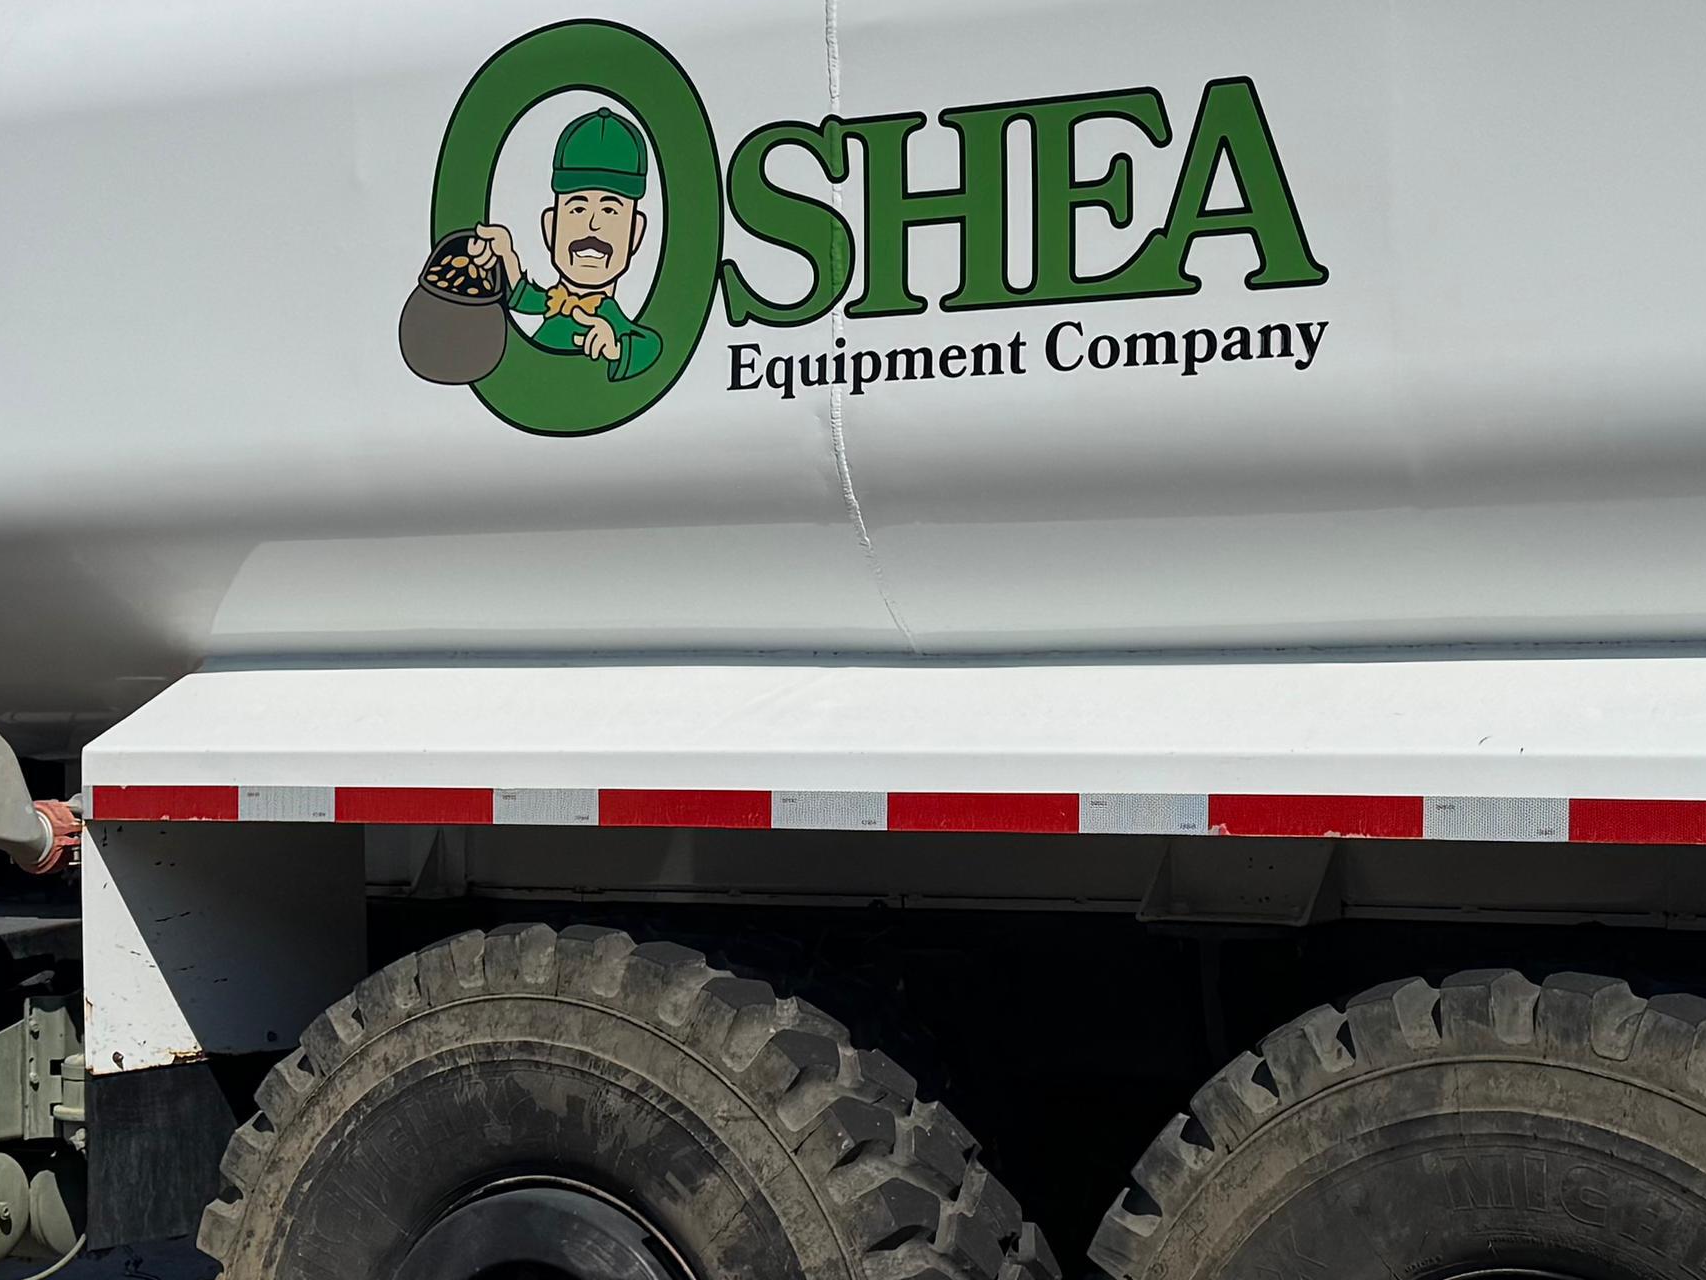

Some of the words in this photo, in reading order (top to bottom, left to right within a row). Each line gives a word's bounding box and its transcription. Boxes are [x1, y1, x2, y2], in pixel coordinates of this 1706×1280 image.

[431, 17, 1330, 438] OSHEA
[725, 330, 1027, 401] Equipment
[1044, 320, 1329, 378] Company
